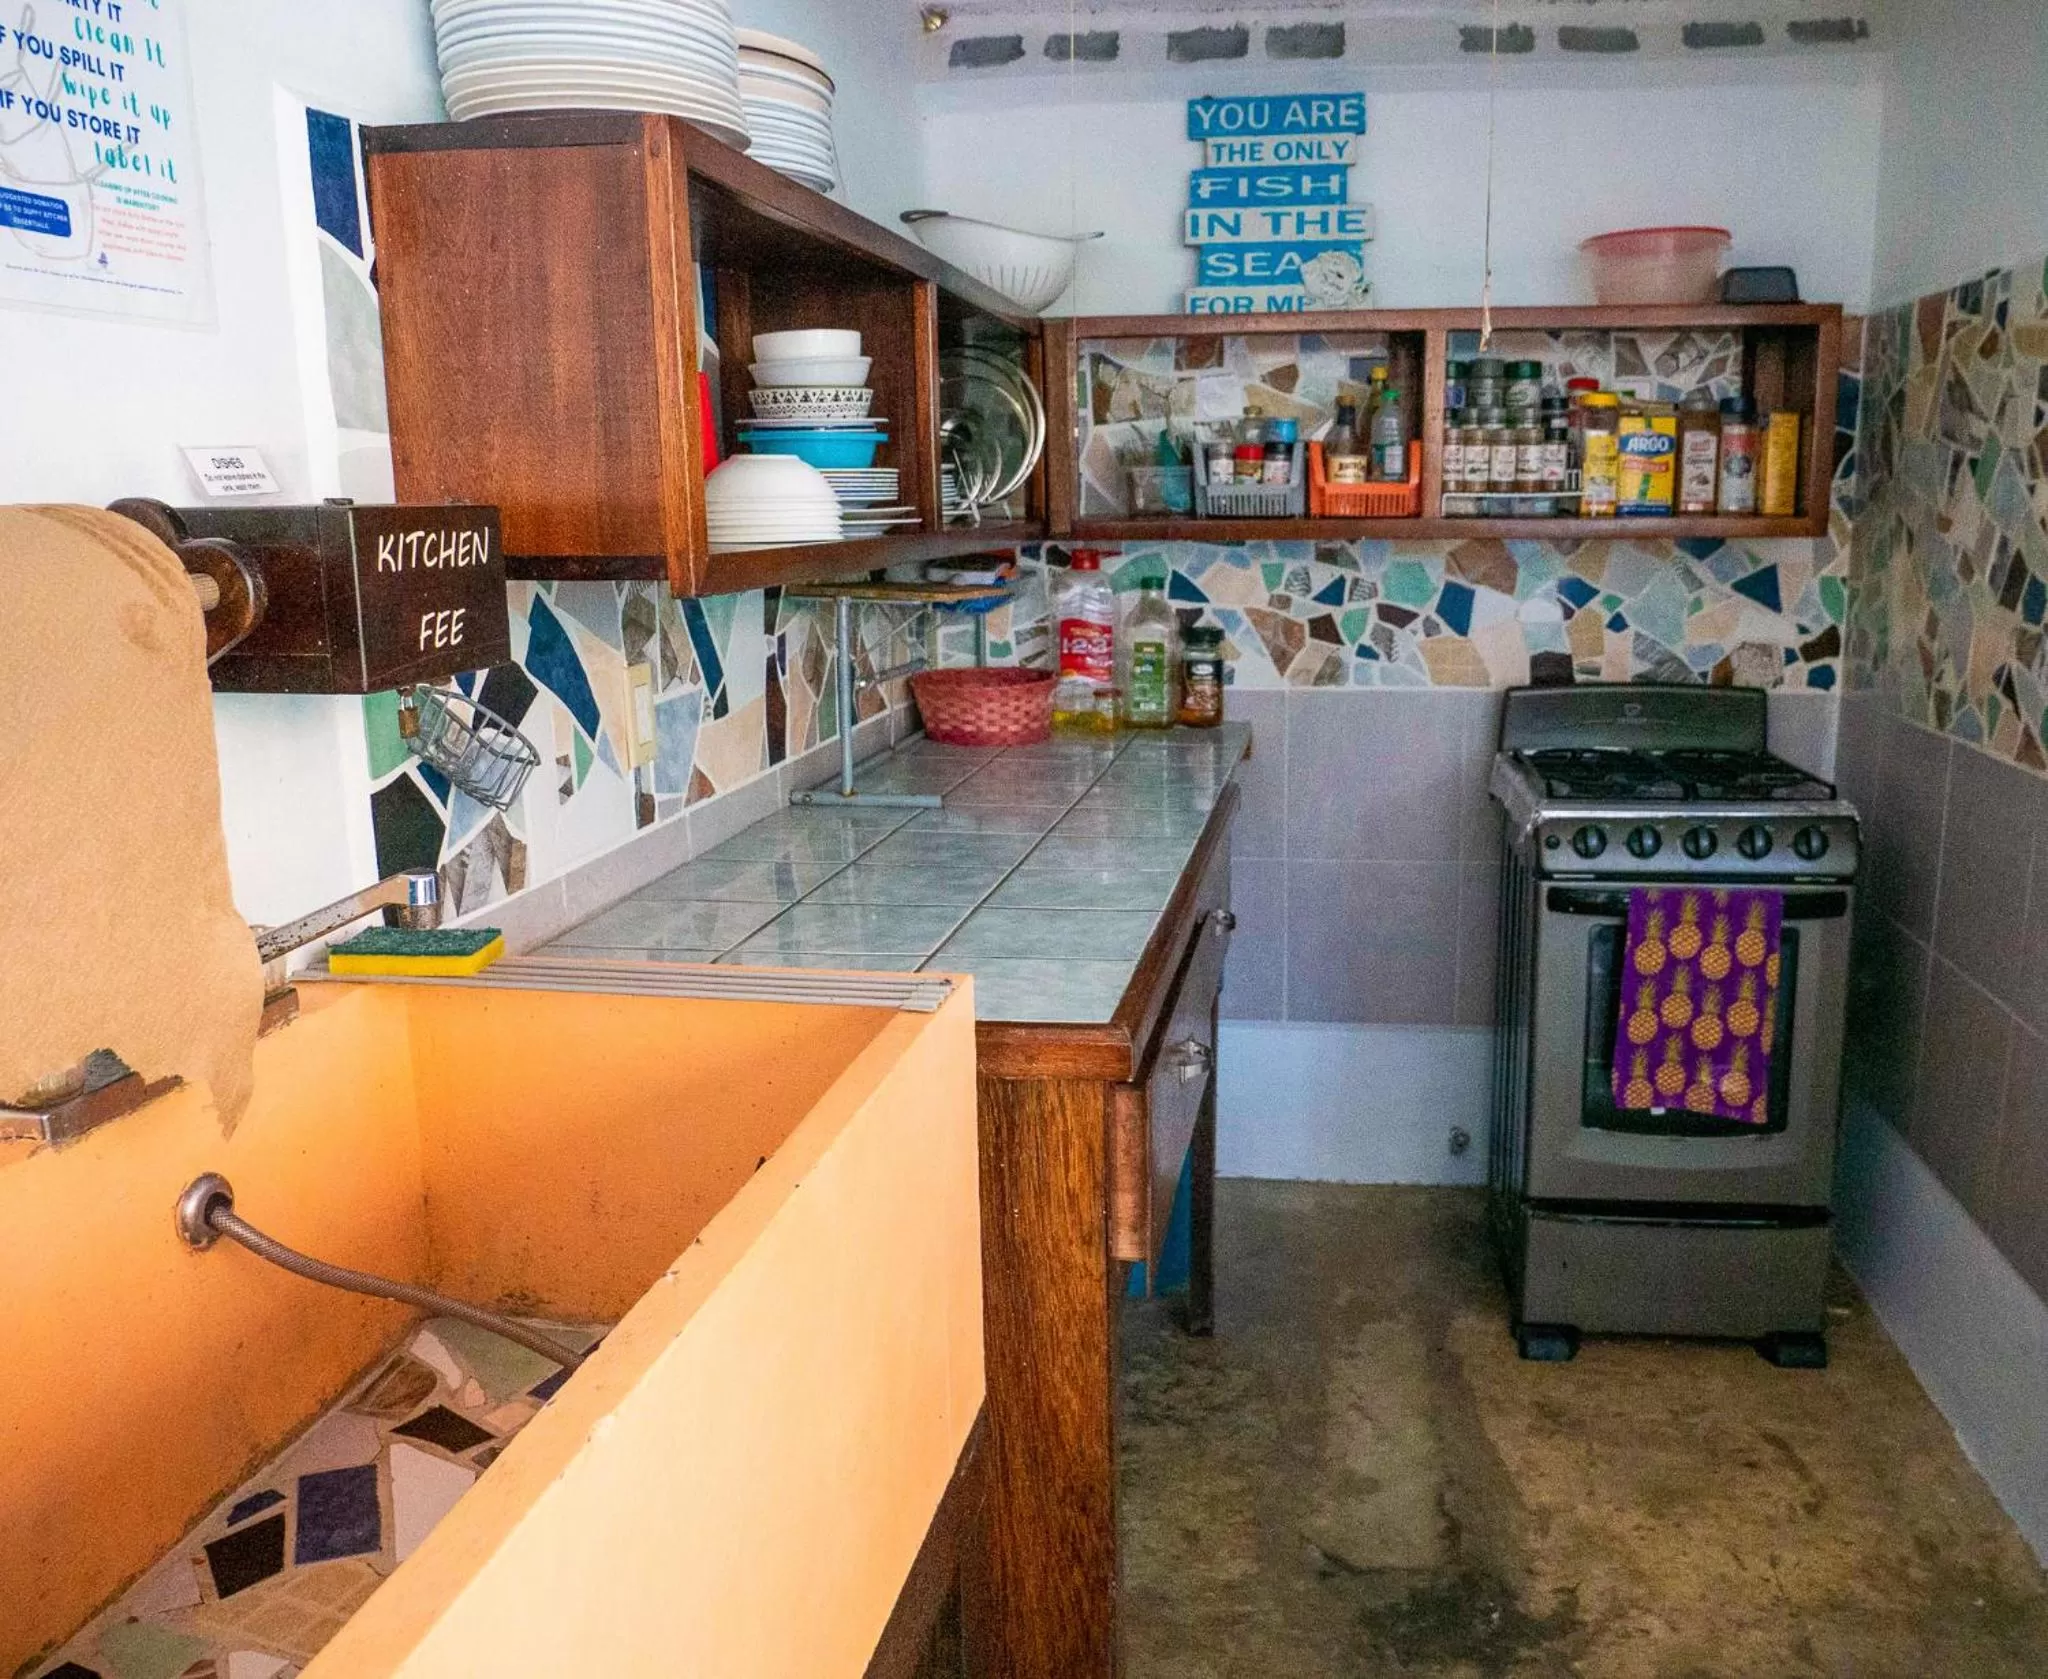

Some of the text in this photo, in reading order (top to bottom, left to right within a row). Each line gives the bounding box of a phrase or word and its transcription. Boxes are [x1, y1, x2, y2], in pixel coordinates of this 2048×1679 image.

[108, 2, 121, 22] IT
[13, 29, 53, 59] YOU
[60, 46, 105, 77] SPILL
[110, 62, 124, 82] IT
[0, 88, 141, 145] IF YOU STORE IT
[151, 104, 171, 130] up
[1195, 99, 1359, 130] YOU ARE
[1211, 140, 1349, 162] THE ONLY
[161, 158, 177, 184] it
[1197, 174, 1341, 199] FISH
[1189, 209, 1367, 237] IN THE
[1206, 251, 1302, 277] SEA
[1190, 296, 1254, 315] FOR
[1626, 436, 1669, 452] ARGO
[378, 526, 489, 572] KITCHEN
[419, 608, 466, 651] FEE
